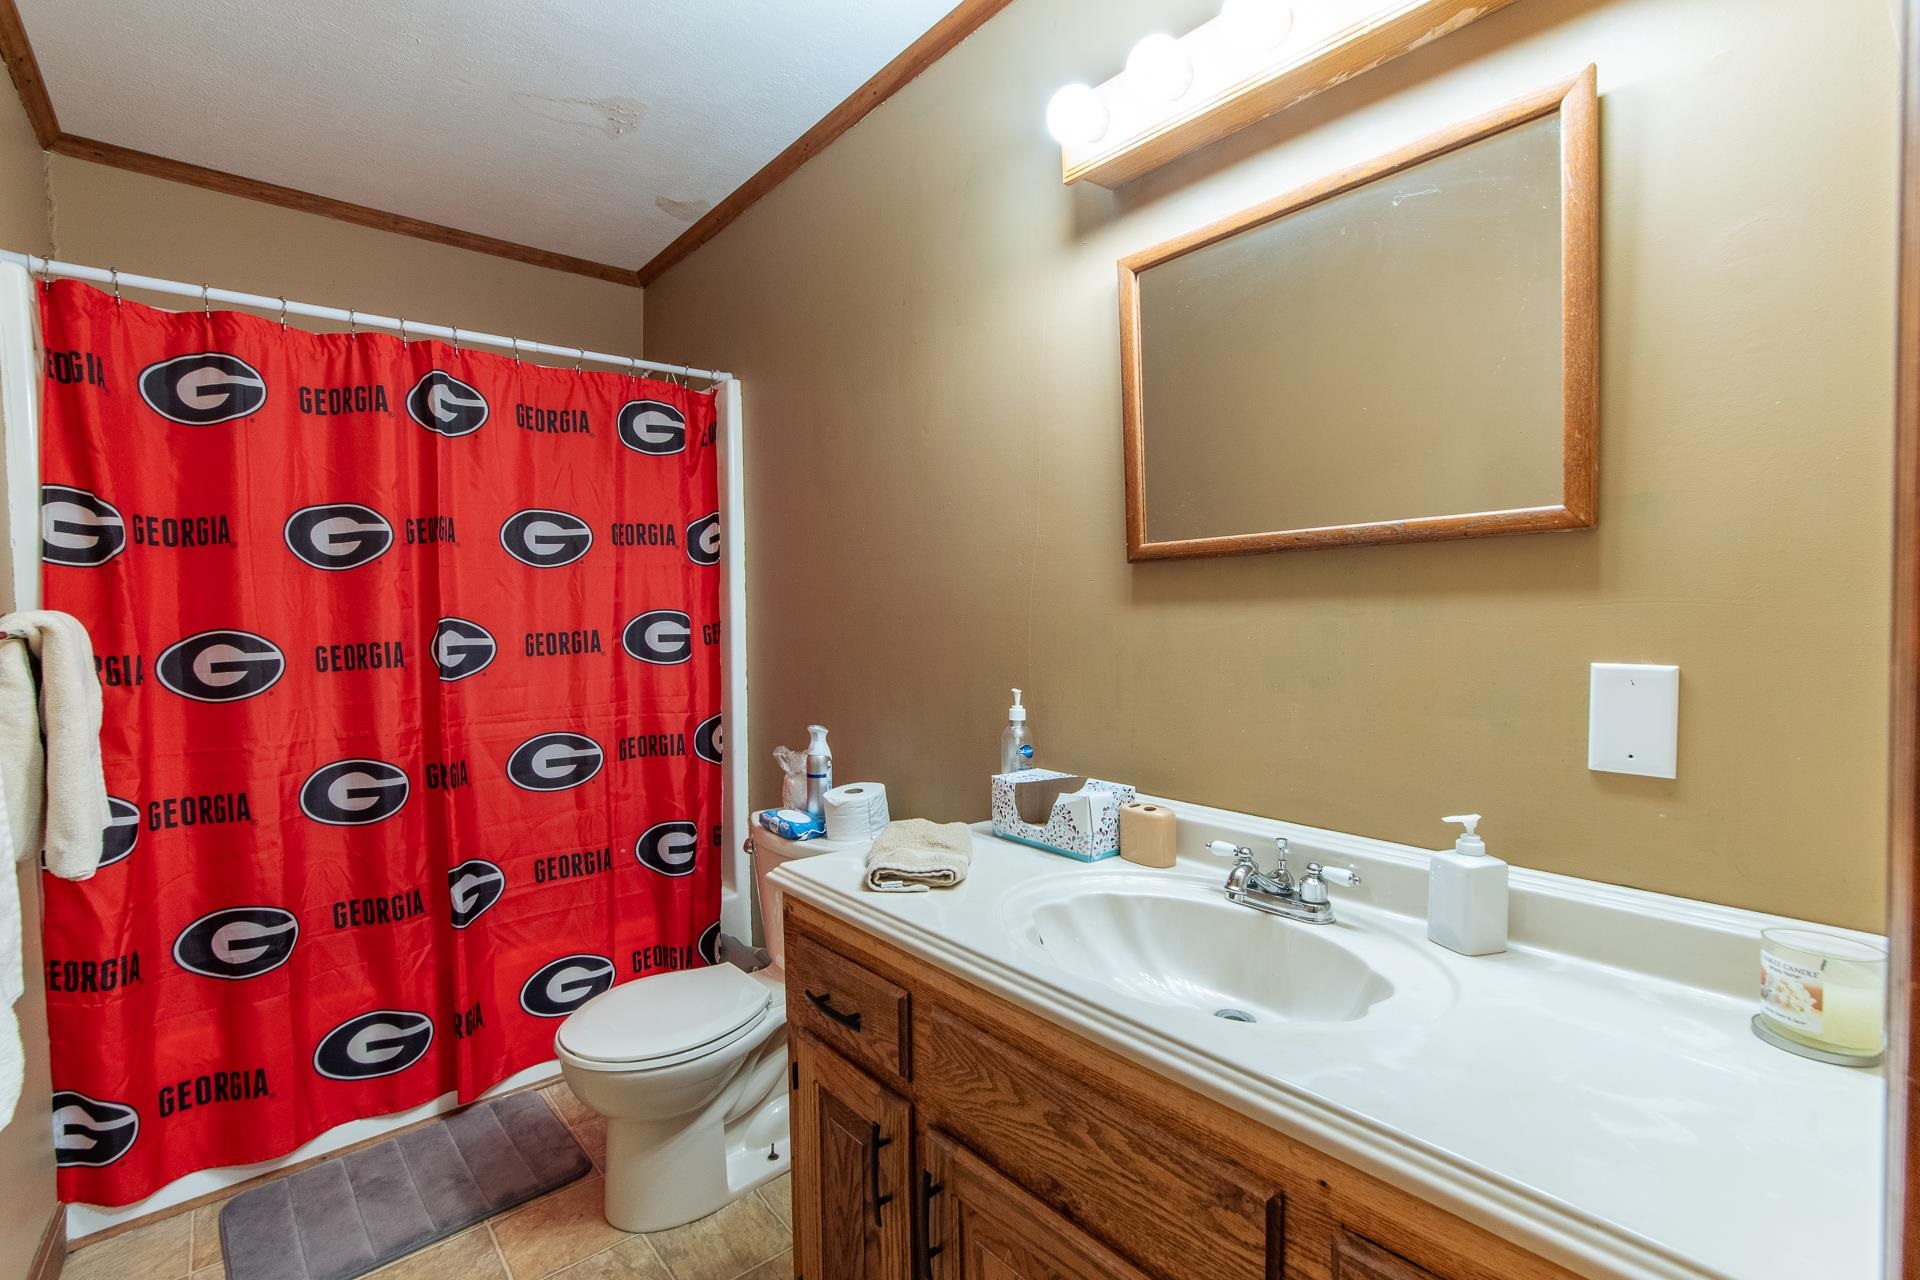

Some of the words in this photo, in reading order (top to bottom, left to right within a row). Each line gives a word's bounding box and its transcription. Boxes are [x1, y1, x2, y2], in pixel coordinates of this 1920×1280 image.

[300, 385, 388, 416] GEORGIA
[516, 403, 590, 434] GEORGIA
[132, 514, 231, 548] GEORGIA
[611, 522, 676, 546] GEORGIA
[315, 642, 404, 674] GEORGIA
[525, 630, 602, 657] GEORGIA
[618, 733, 686, 761] GEORGIA
[148, 792, 251, 832] GEORGIA
[534, 848, 612, 884] GEORGIA
[333, 889, 424, 930] GEORGIA
[49, 950, 141, 992] EORGIA
[632, 944, 694, 974] GEORGIA
[159, 1068, 270, 1119] GEORGIA
